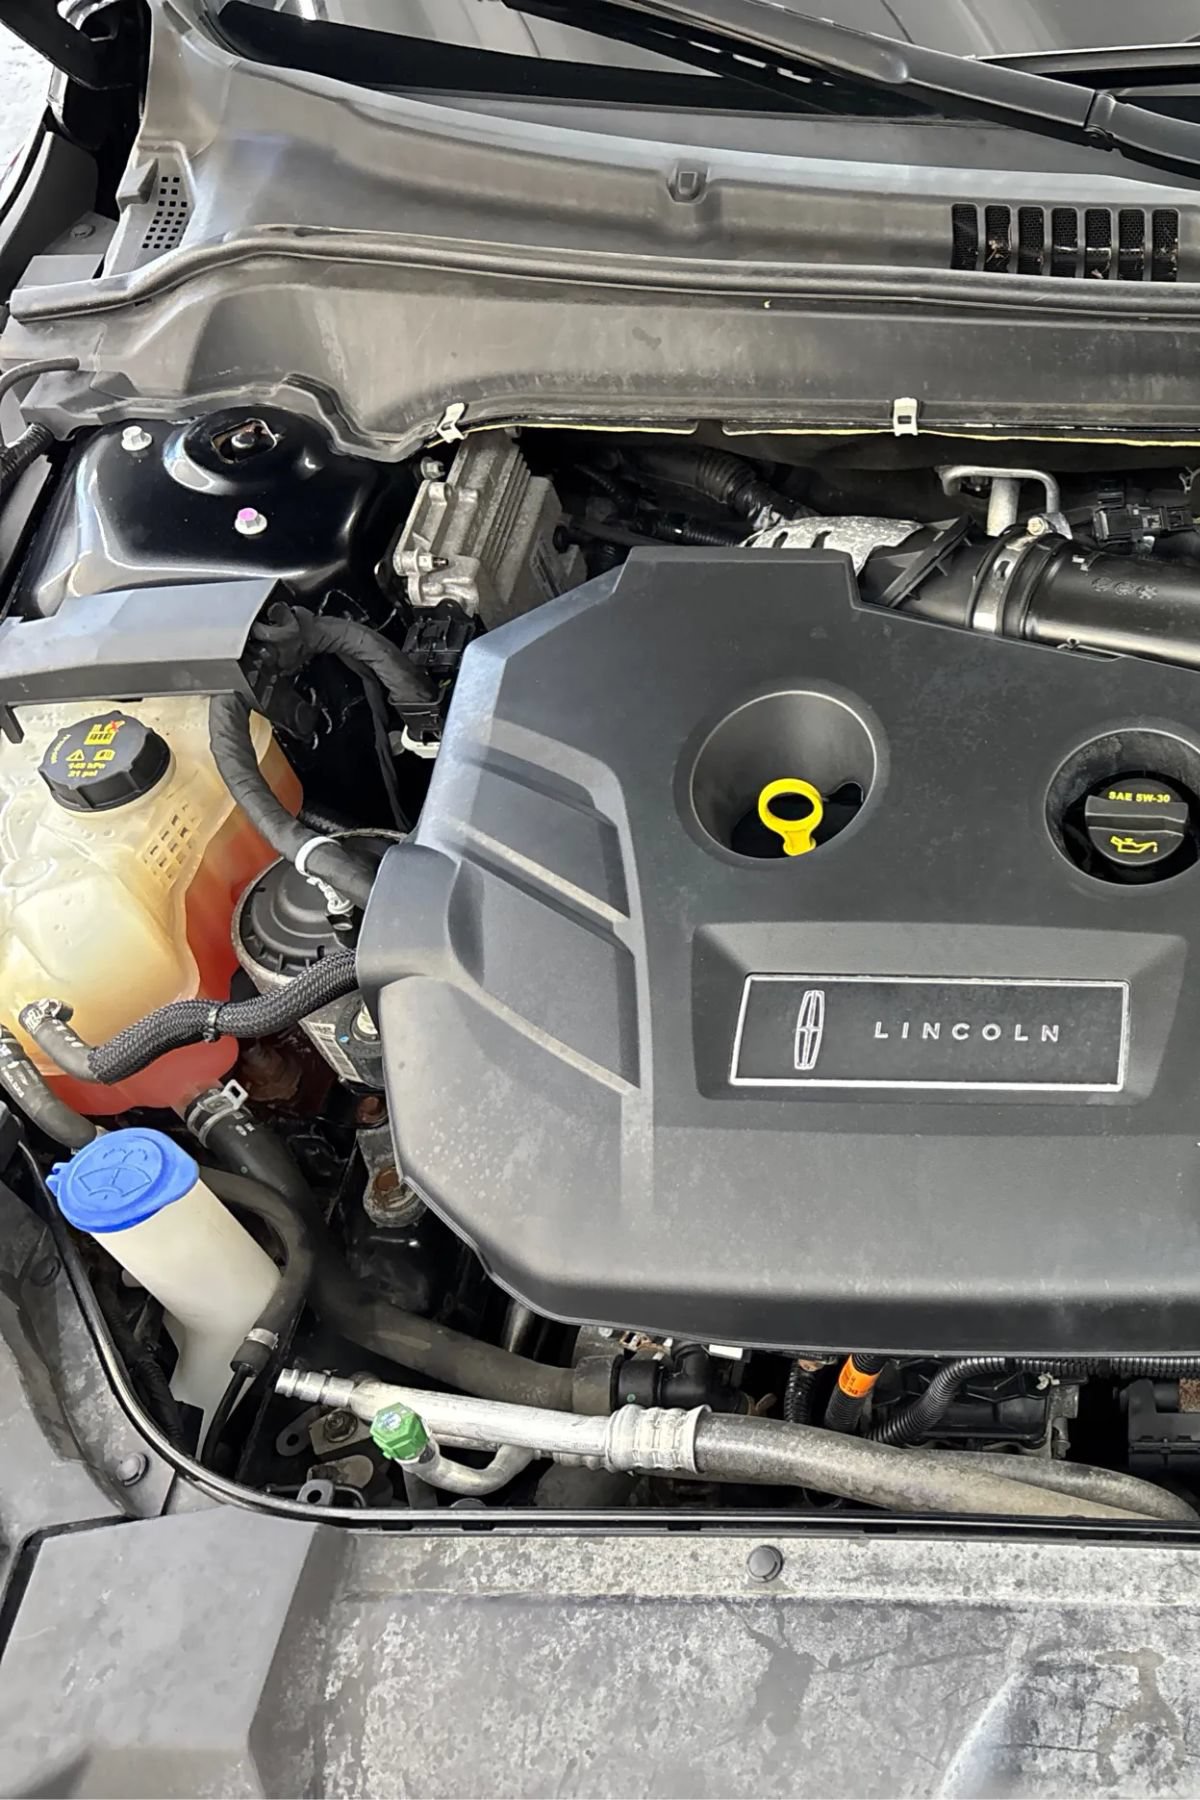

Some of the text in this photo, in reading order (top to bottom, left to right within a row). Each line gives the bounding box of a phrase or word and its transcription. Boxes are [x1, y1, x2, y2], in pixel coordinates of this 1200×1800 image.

[1108, 791, 1171, 804] SAE 5W-30
[873, 1020, 1060, 1043] LINCOLN
